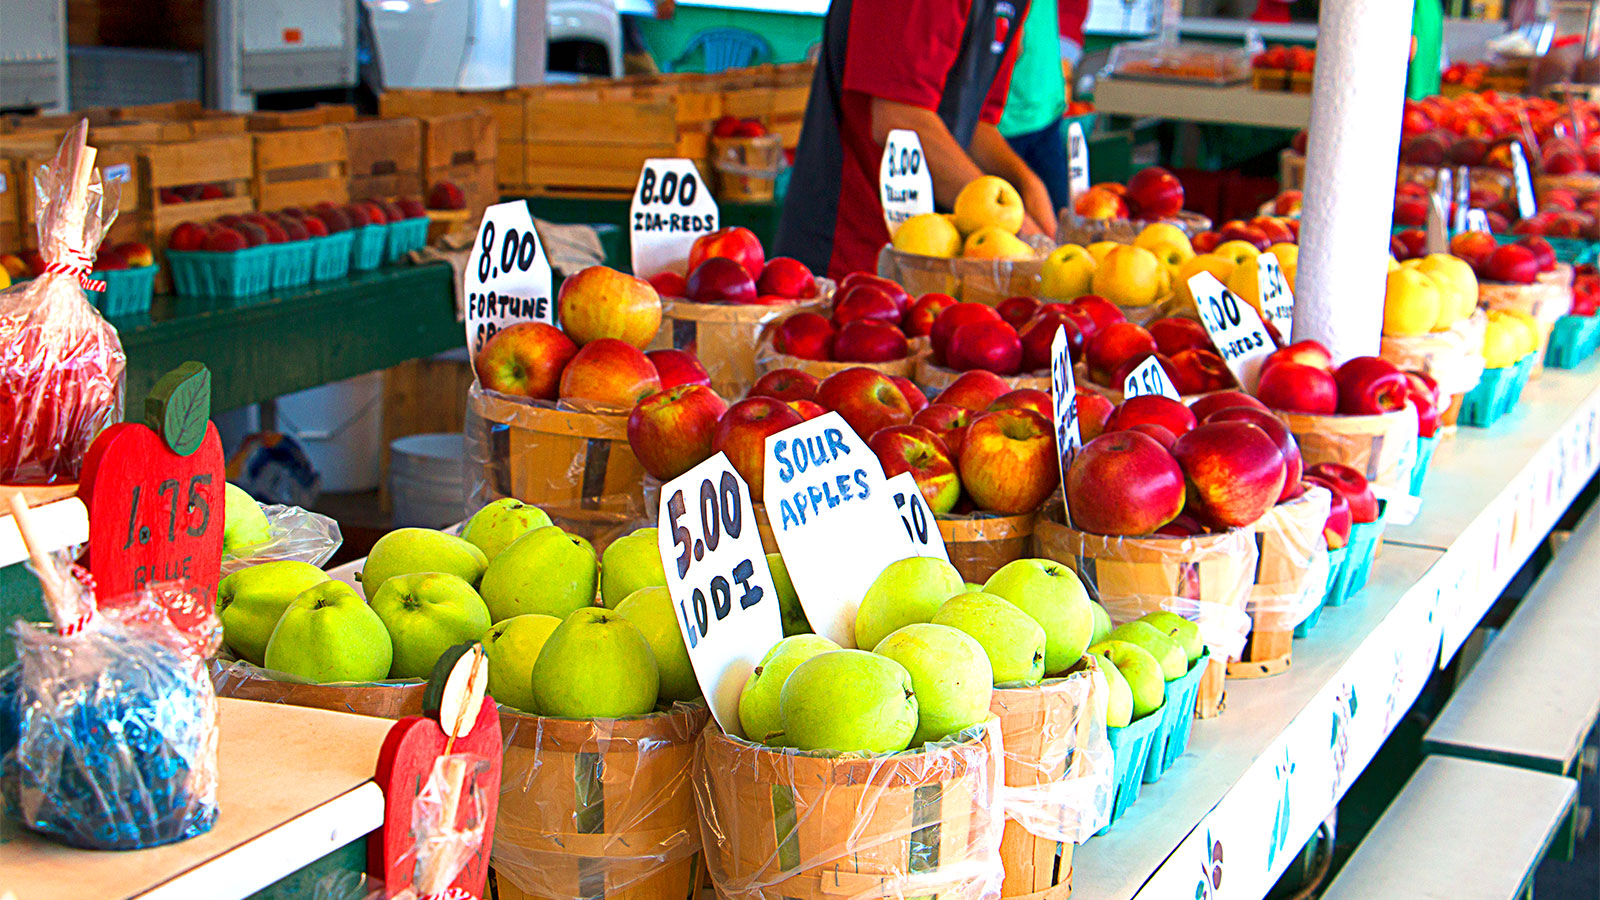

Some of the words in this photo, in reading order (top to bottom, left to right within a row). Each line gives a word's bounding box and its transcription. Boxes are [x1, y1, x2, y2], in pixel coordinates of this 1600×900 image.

[888, 141, 921, 178] 8.00
[640, 167, 697, 207] 8.00
[634, 212, 714, 232] IDA-REDS
[478, 220, 536, 284] 8.00
[469, 291, 549, 321] FORTUNE
[475, 322, 502, 353] SP
[774, 428, 851, 484] SOUR
[123, 473, 212, 550] 1.75
[667, 470, 742, 581] 5.00
[780, 469, 871, 531] APPLES
[893, 492, 928, 545] 50
[134, 556, 192, 597] BLUE
[680, 559, 764, 649] LODI
